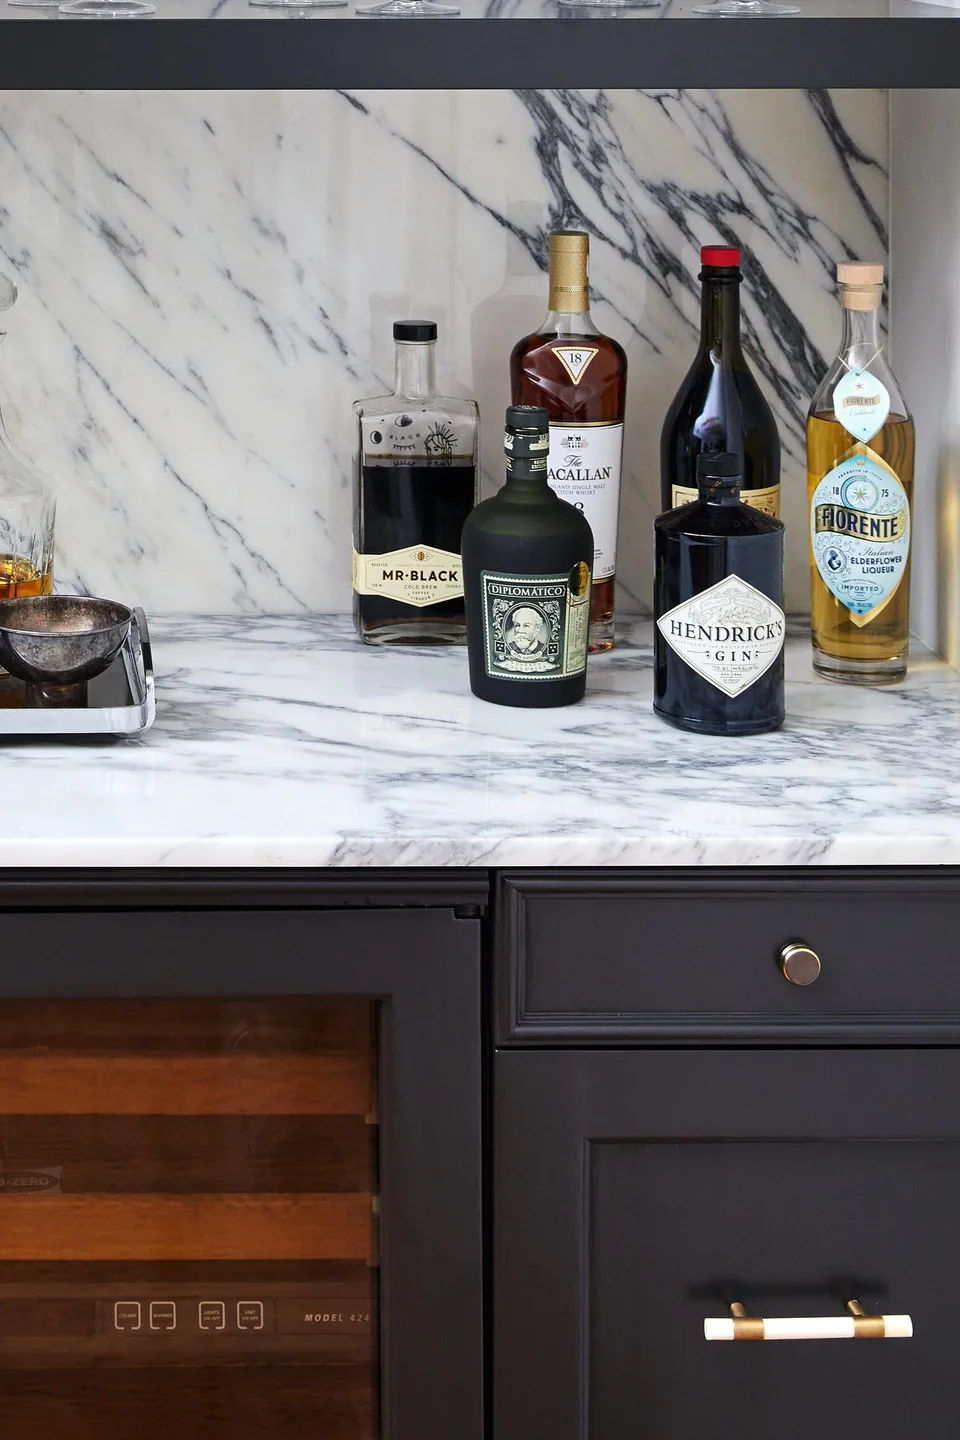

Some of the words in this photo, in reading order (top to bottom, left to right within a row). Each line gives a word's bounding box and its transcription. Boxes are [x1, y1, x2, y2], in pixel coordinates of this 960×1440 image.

[570, 353, 582, 364] 18
[562, 454, 583, 467] The
[547, 466, 612, 481] ACALLAN
[832, 486, 839, 495] 18
[881, 489, 889, 497] 75
[822, 508, 898, 538] FIORENTE
[859, 546, 894, 557] Italian
[850, 555, 903, 565] ELDERFLOWER
[862, 566, 895, 574] LIQUEUR
[491, 586, 563, 596] DIPLOMÁTICO
[841, 584, 880, 592] IMPORTED
[670, 619, 783, 641] HENDRICK'S
[715, 651, 751, 661] GIN
[304, 1313, 344, 1322] MODEL
